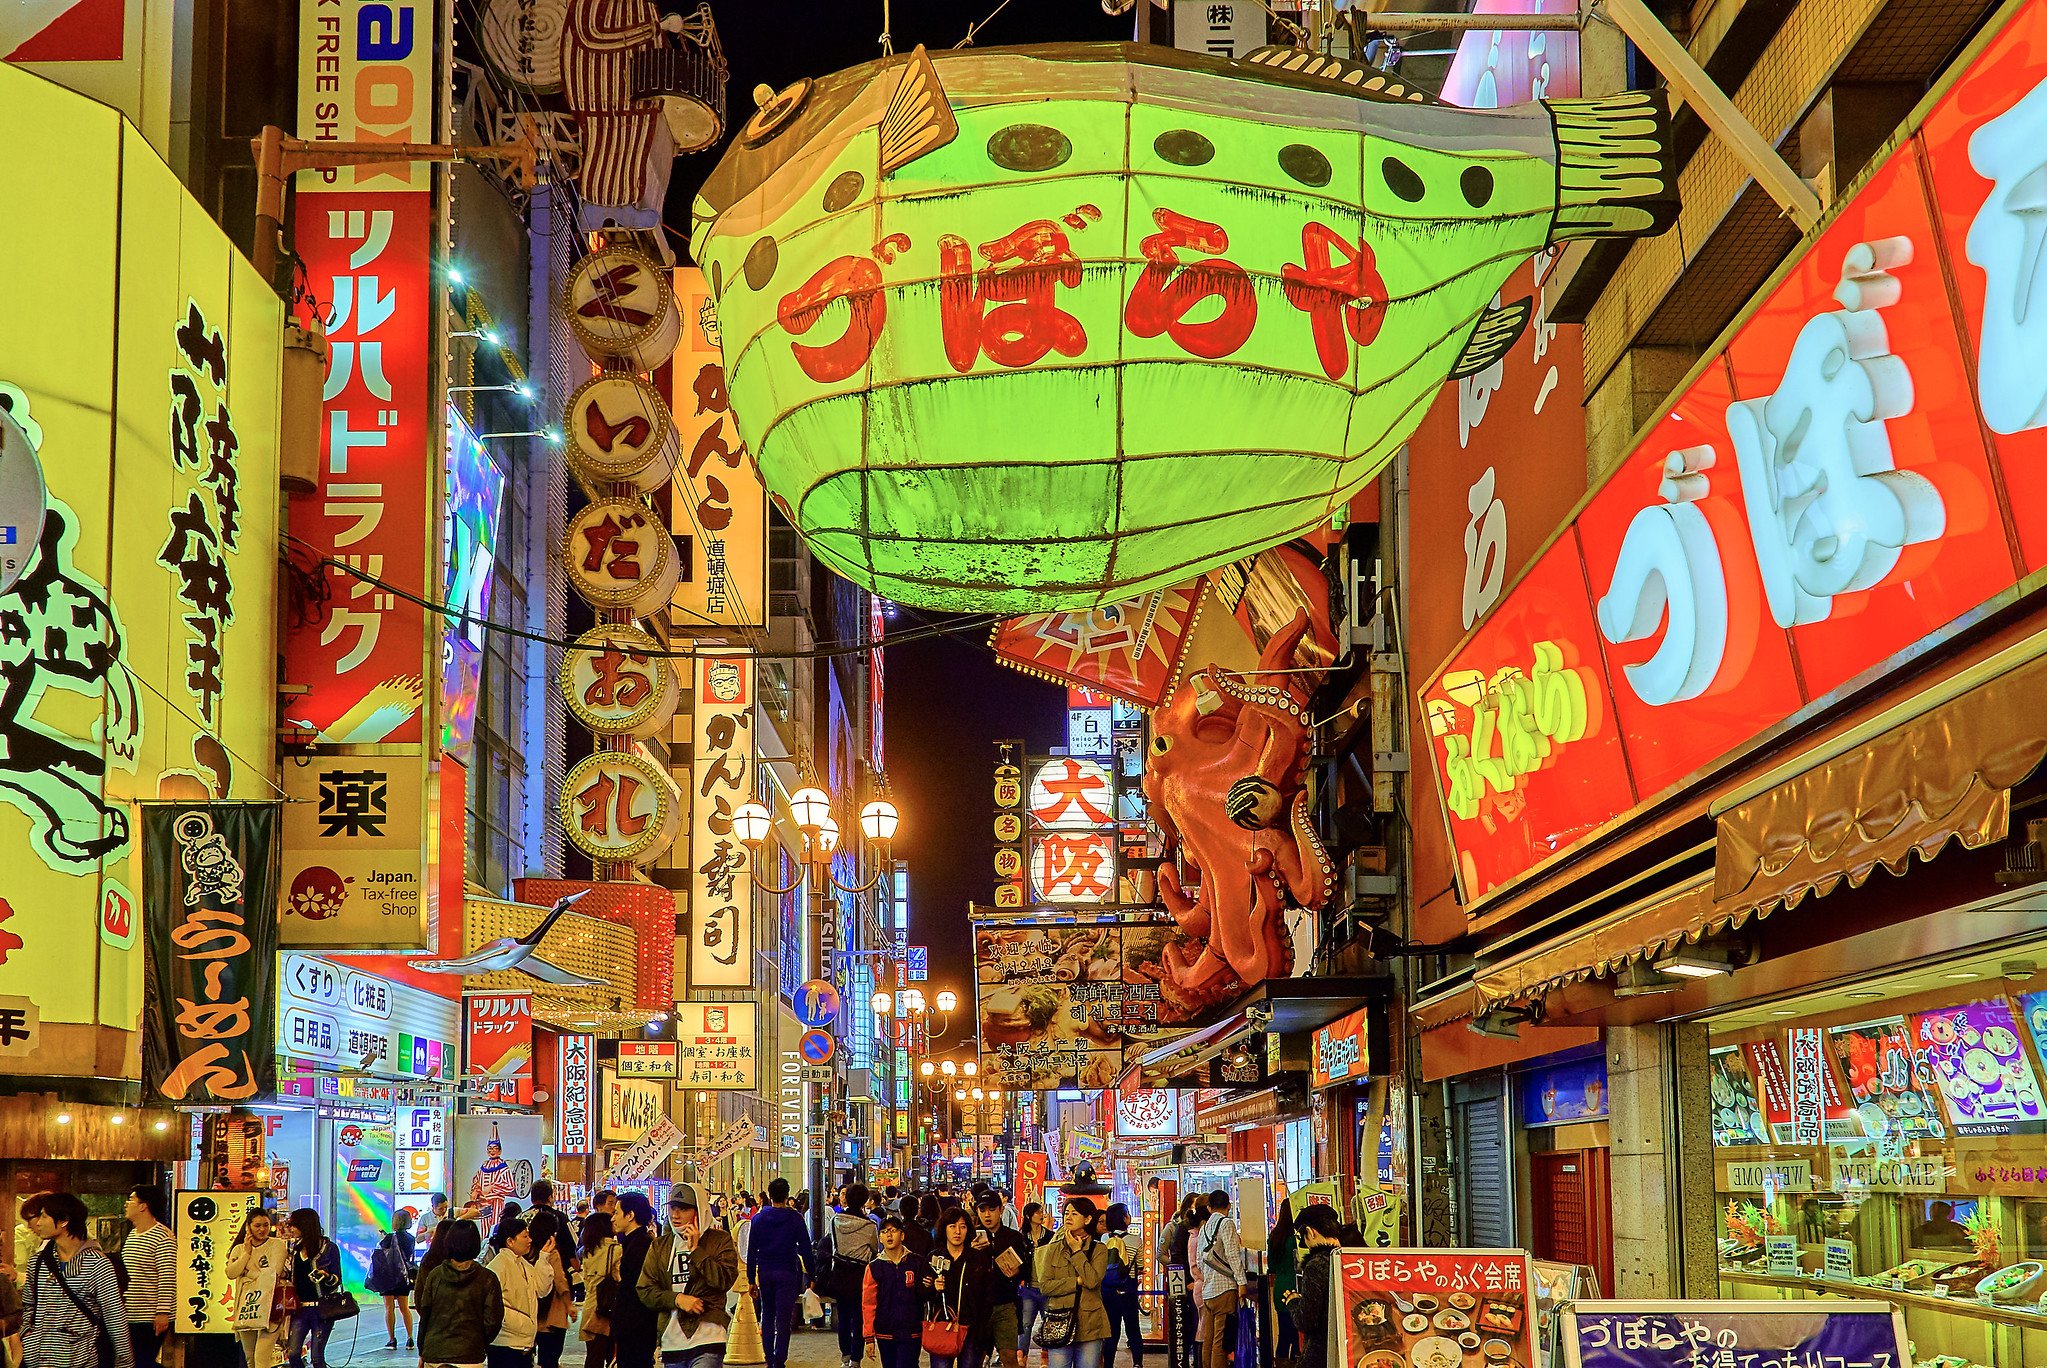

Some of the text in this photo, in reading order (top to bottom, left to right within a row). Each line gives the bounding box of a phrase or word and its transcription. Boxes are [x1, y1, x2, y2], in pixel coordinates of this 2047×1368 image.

[314, 17, 340, 184] FREE SHP
[777, 204, 1389, 383] づぼらや
[321, 210, 398, 675] ツルハドラッグ
[706, 540, 727, 614] 道頓堀店
[1071, 713, 1082, 721] 4F
[1085, 715, 1109, 757] 白木
[319, 770, 387, 837] 薬
[1032, 760, 1116, 897] 大阪
[367, 870, 417, 884] Japan.
[360, 888, 418, 902] Tax-free
[381, 903, 418, 919] Shop
[295, 963, 333, 998] くすり
[993, 957, 1055, 975] 어서오세요
[160, 907, 260, 1101] らーめん
[353, 979, 386, 1012] 化粧品
[473, 998, 530, 1018] ツルハ
[473, 1020, 519, 1035] ドラッグ
[1070, 1003, 1159, 1023] 해선호프집
[294, 1017, 331, 1050] 日用品
[620, 1060, 674, 1073] 個室・和食
[683, 1046, 752, 1059] 個室・お座敷
[689, 1070, 746, 1083] 寿司・和食
[801, 1069, 831, 1079] 自動車
[565, 1043, 587, 1146] 大阪紀念品
[781, 1051, 801, 1132] FOREVER
[410, 1109, 431, 1191] Laox
[1839, 1162, 1937, 1187] WELCOME
[1171, 1271, 1184, 1294] 入口
[1343, 1258, 1522, 1292] づぼらやのふぐ会席
[1579, 1318, 1739, 1351] づぼらやの
